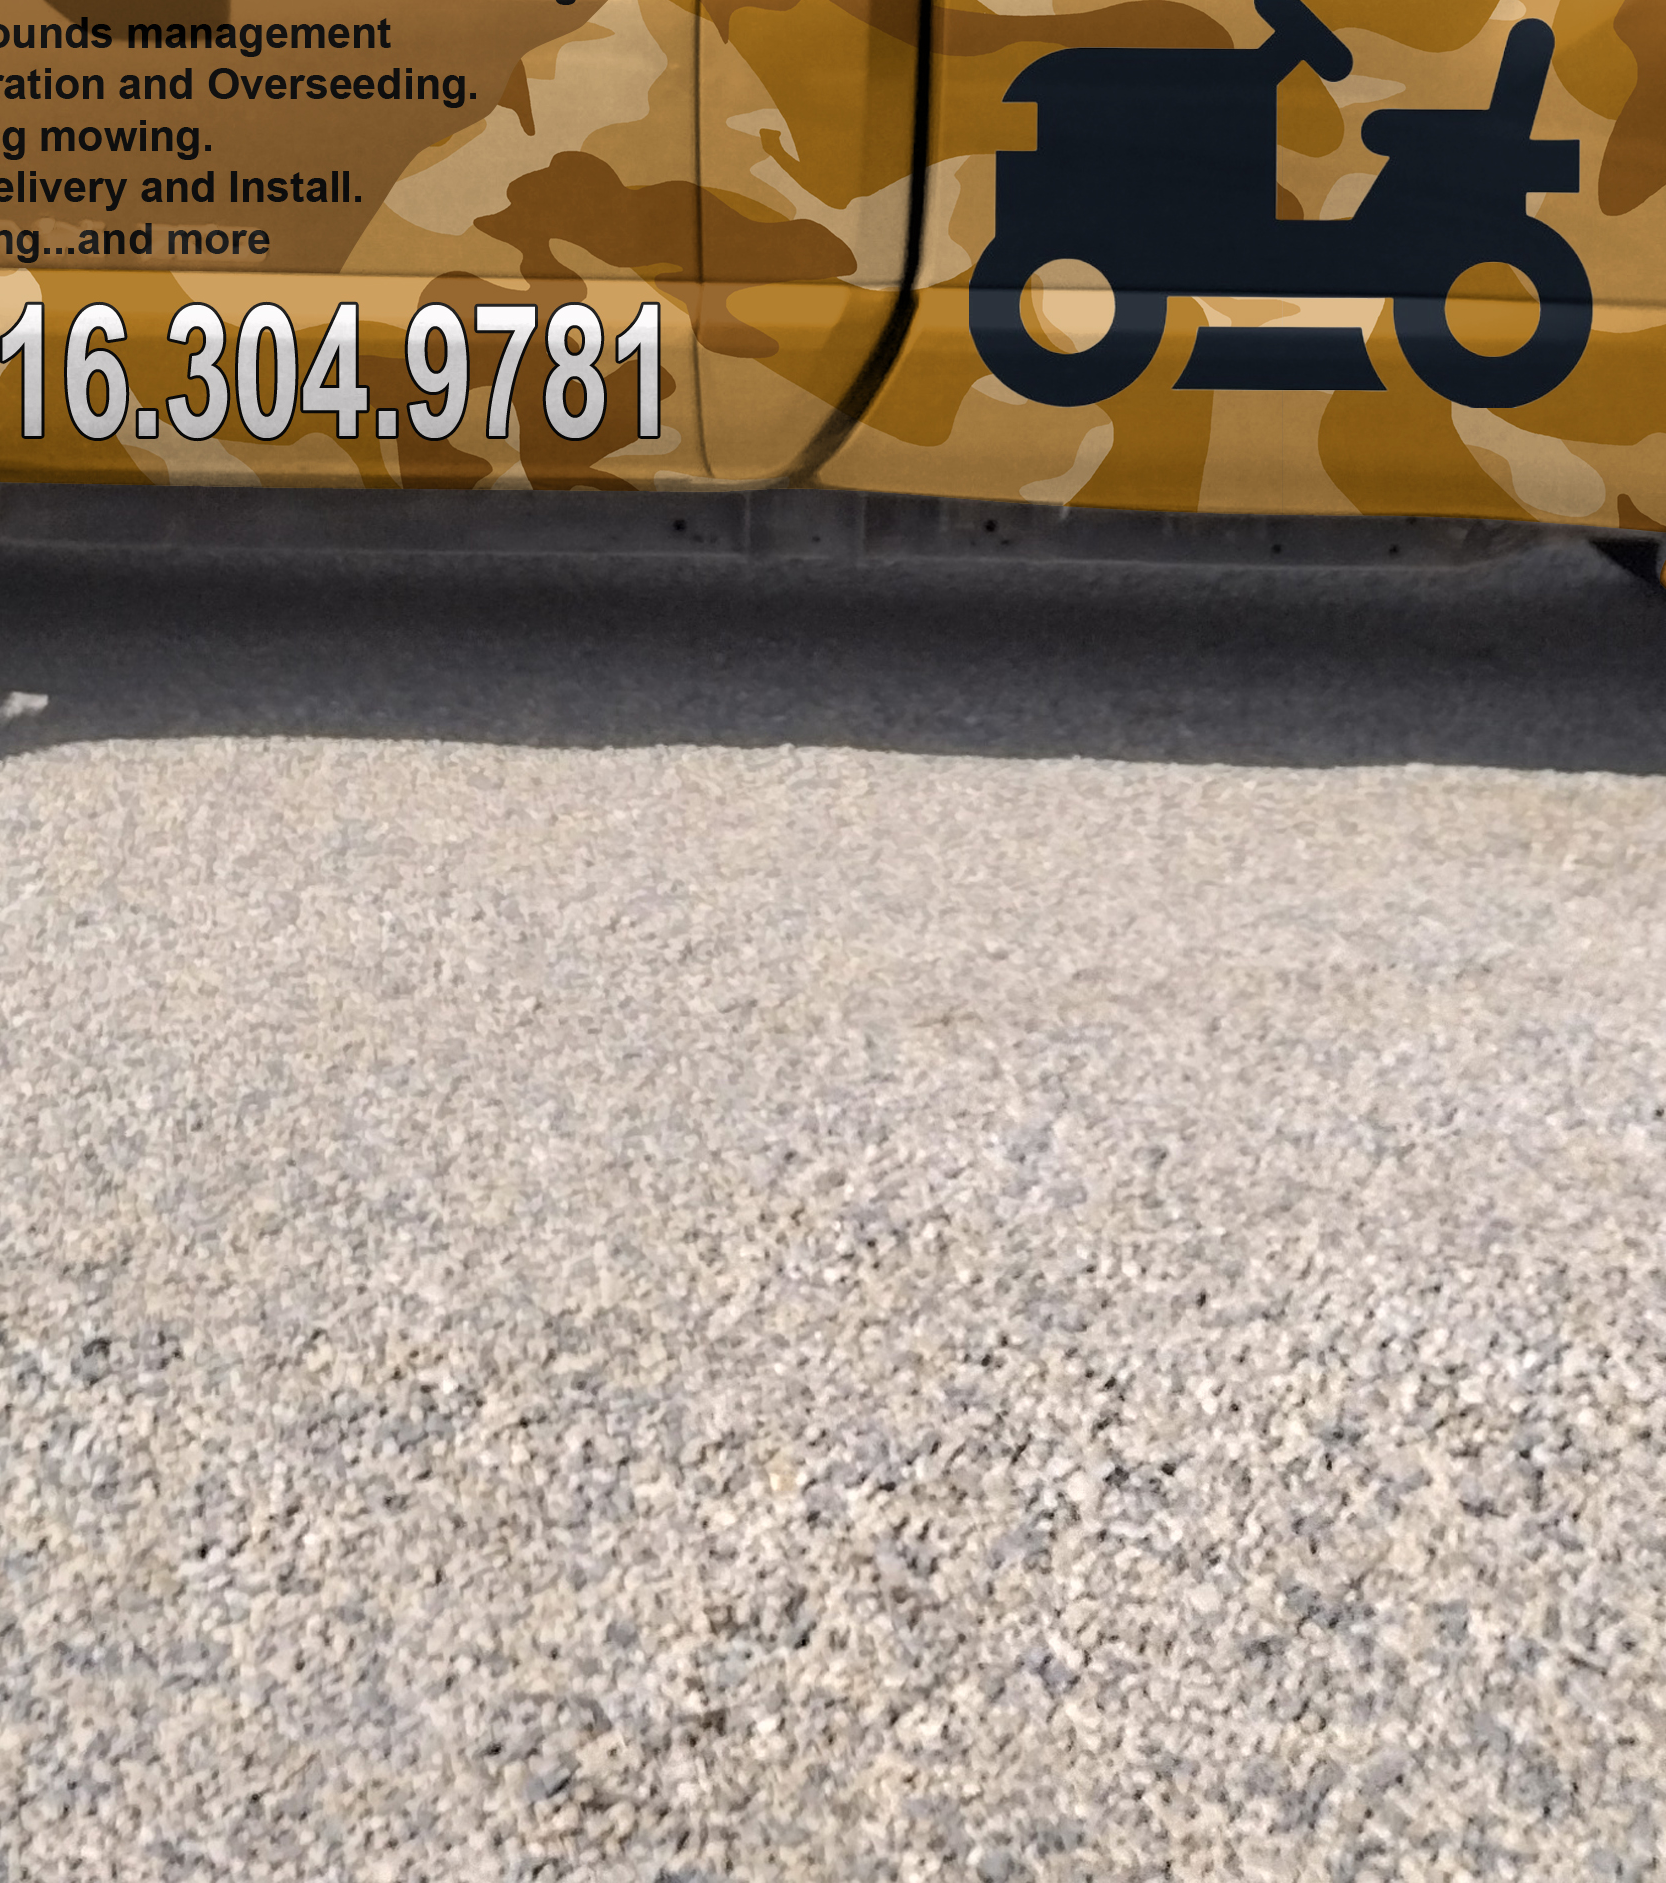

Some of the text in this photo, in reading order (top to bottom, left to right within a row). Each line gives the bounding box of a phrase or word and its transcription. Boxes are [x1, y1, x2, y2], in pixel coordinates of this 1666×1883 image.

[128, 18, 391, 58] management
[119, 67, 192, 100] and
[207, 67, 477, 109] Overseeding.
[41, 119, 212, 161] mowing.
[140, 170, 215, 203] and
[230, 170, 362, 203] Install.
[167, 228, 271, 255] more
